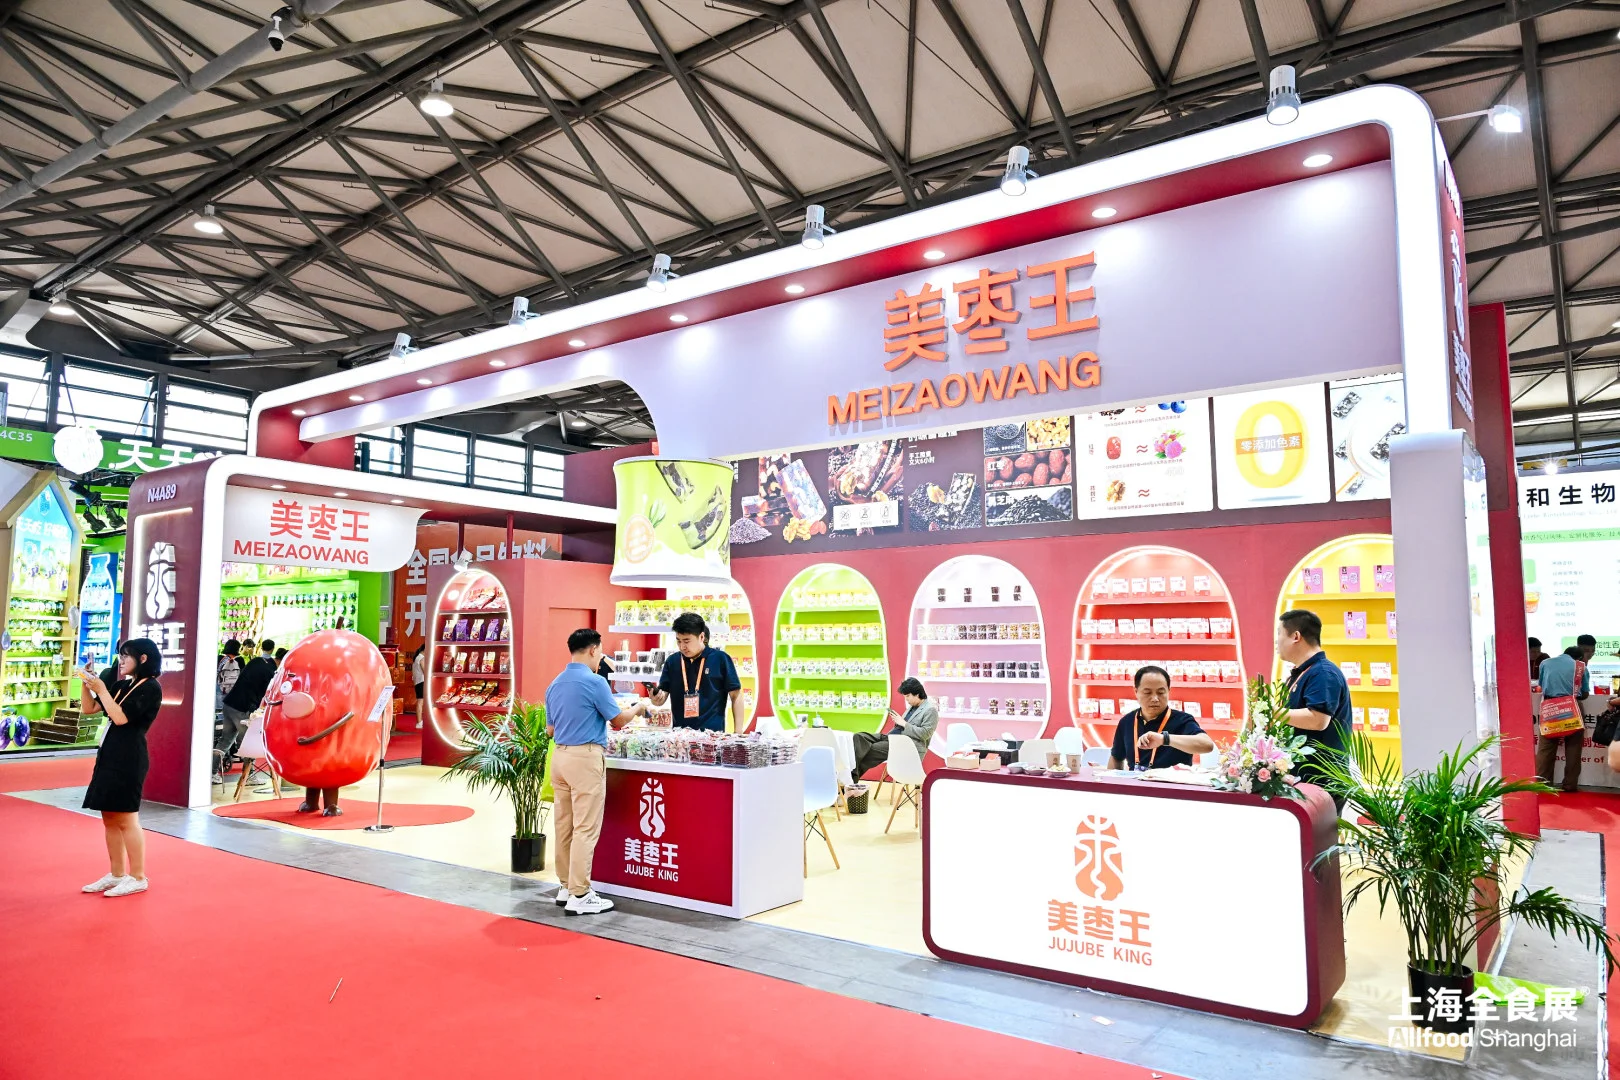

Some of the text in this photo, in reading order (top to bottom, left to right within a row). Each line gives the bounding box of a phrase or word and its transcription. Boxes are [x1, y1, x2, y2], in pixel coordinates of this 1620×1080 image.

[883, 251, 1101, 372] 美枣王
[827, 351, 1102, 426] MEIZAOWANG
[147, 483, 177, 503] N4A89
[1526, 483, 1615, 507] 和生物
[270, 499, 370, 543] 美枣王
[233, 539, 369, 565] MEIZAOWANG
[625, 837, 679, 869] 美枣王
[624, 864, 679, 882] JUJUBE KING
[1048, 899, 1152, 947] 美枣王
[1048, 936, 1152, 966] JUJUBE KING
